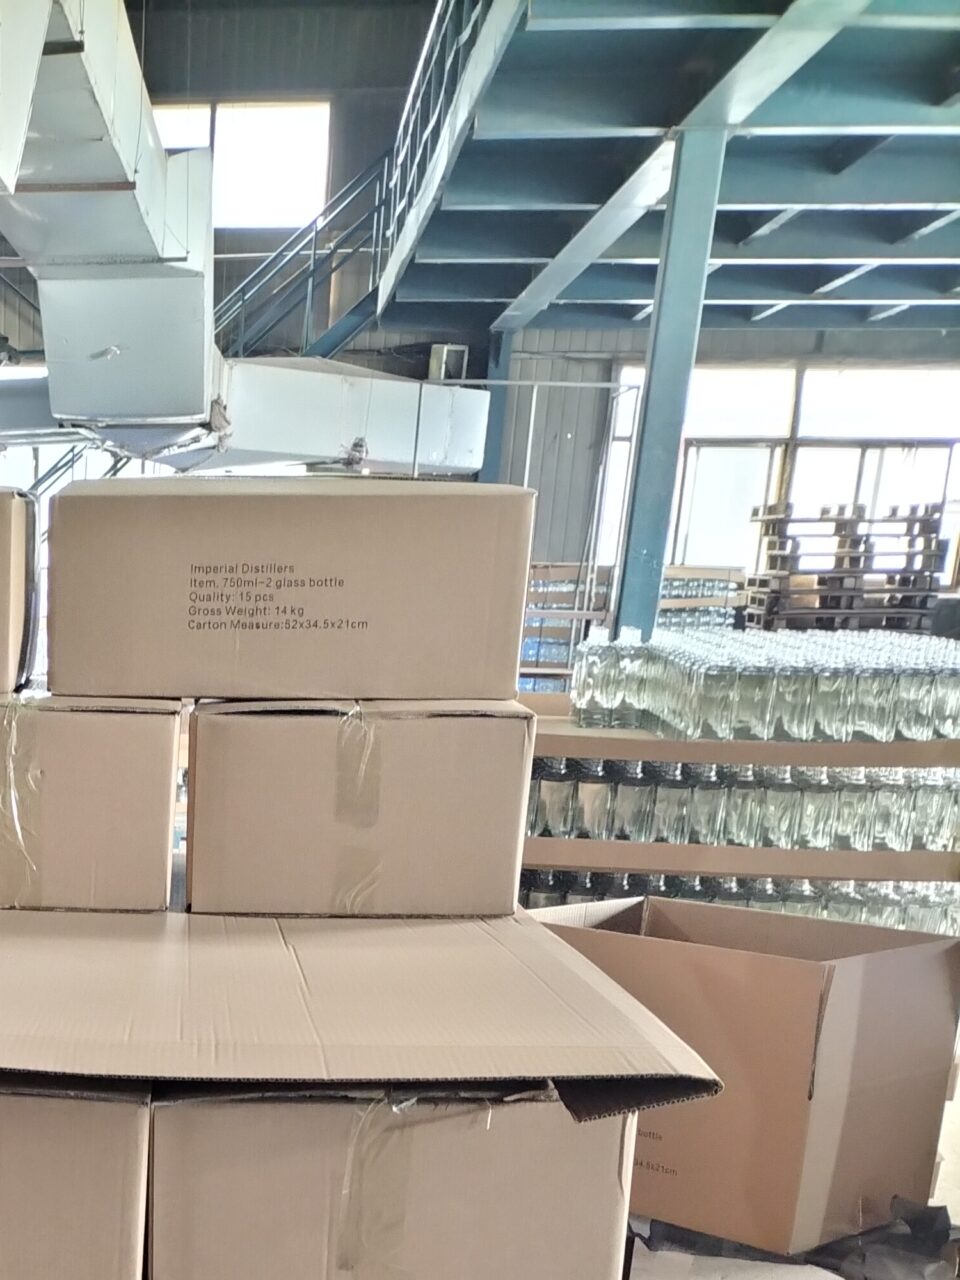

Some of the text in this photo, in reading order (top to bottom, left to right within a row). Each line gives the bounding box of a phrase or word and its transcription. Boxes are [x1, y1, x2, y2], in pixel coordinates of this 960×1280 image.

[190, 564, 294, 576] Imperial Distillers
[276, 578, 305, 589] glass
[309, 578, 344, 587] bottle
[189, 592, 274, 603] Quality: 15 pcs
[188, 606, 304, 617] Gross Weight: 14 kg
[188, 620, 226, 630] Carton
